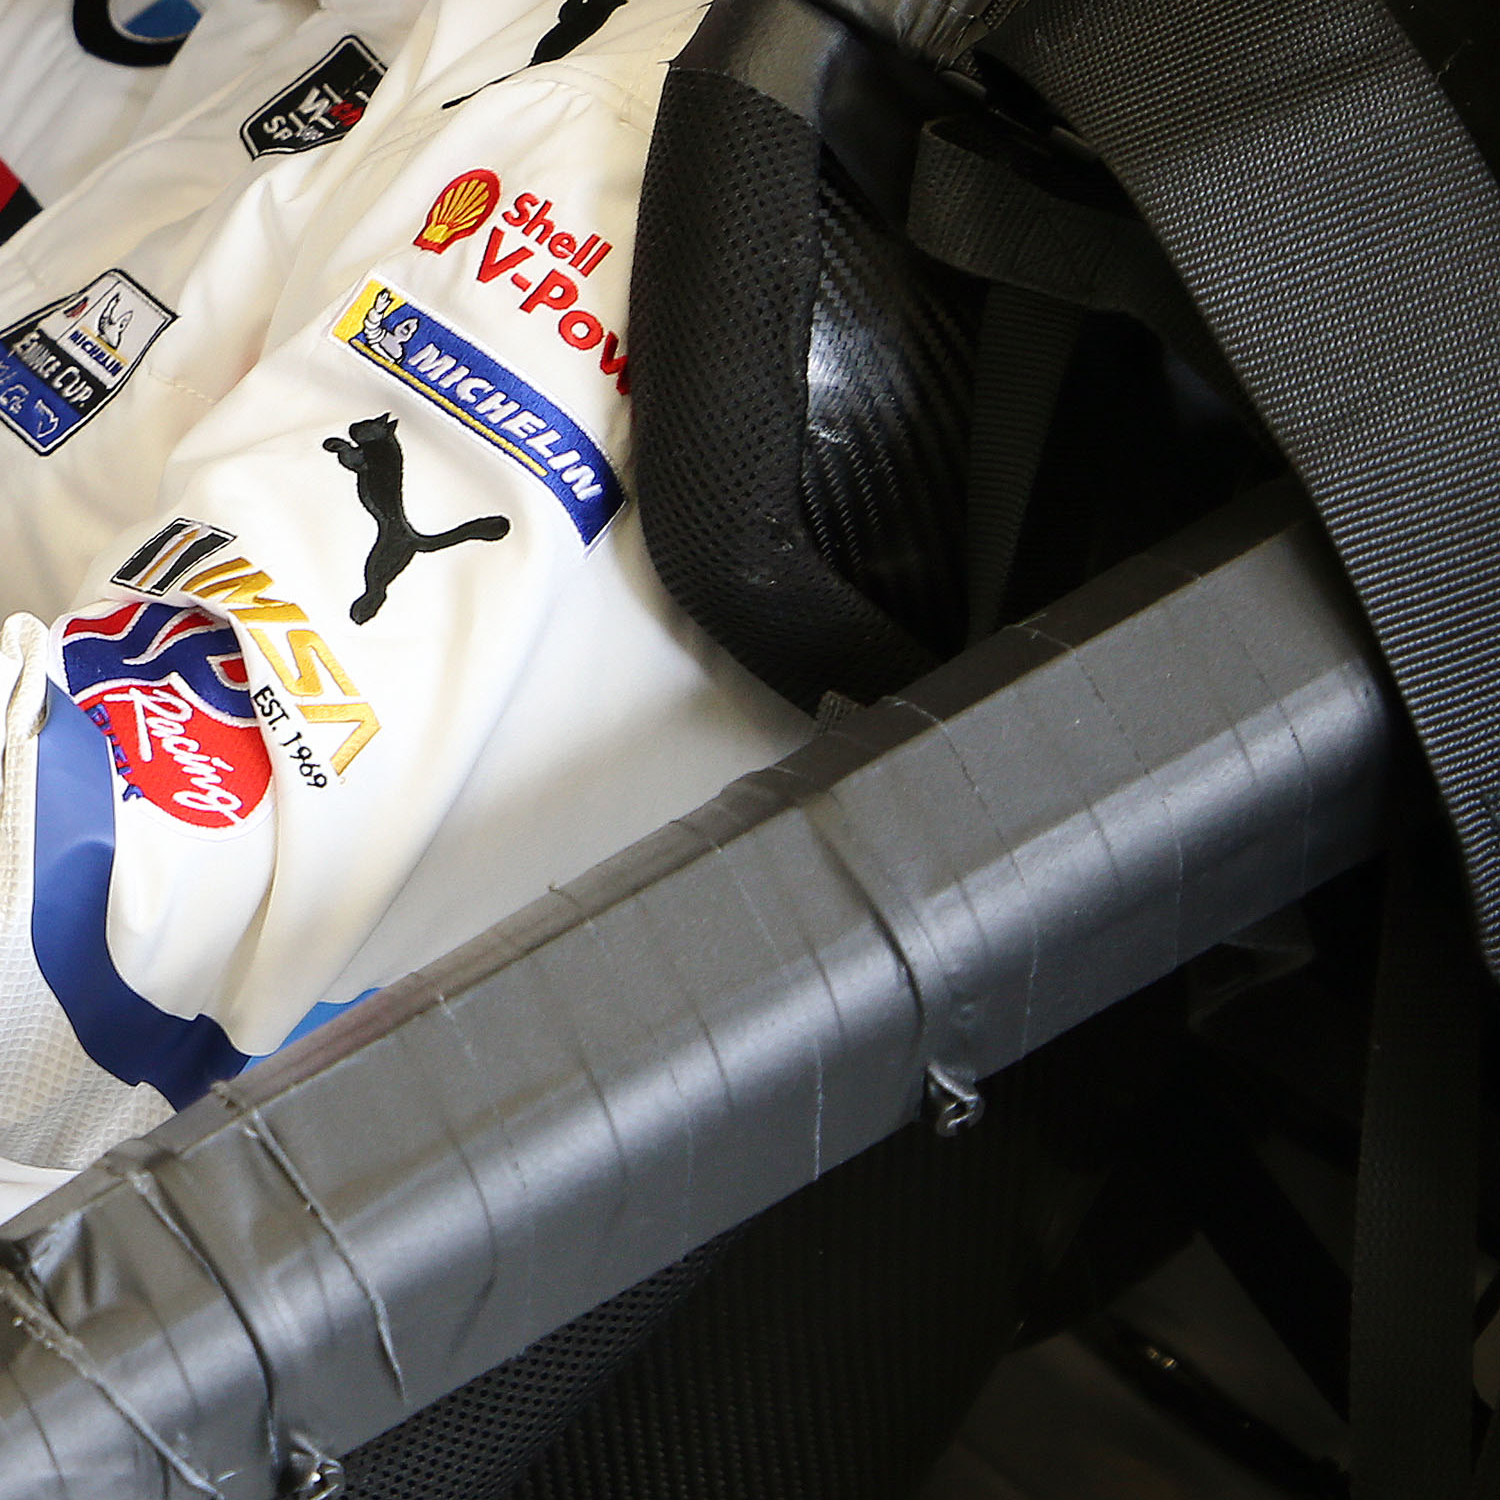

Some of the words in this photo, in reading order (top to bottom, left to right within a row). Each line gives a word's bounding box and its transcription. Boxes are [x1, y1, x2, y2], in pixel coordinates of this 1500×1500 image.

[502, 192, 613, 278] Shell
[406, 342, 604, 502] MICHELIN
[180, 556, 381, 776] IMSA
[252, 684, 290, 732] EST.
[280, 731, 328, 788] 1969
[103, 686, 244, 826] Racing
